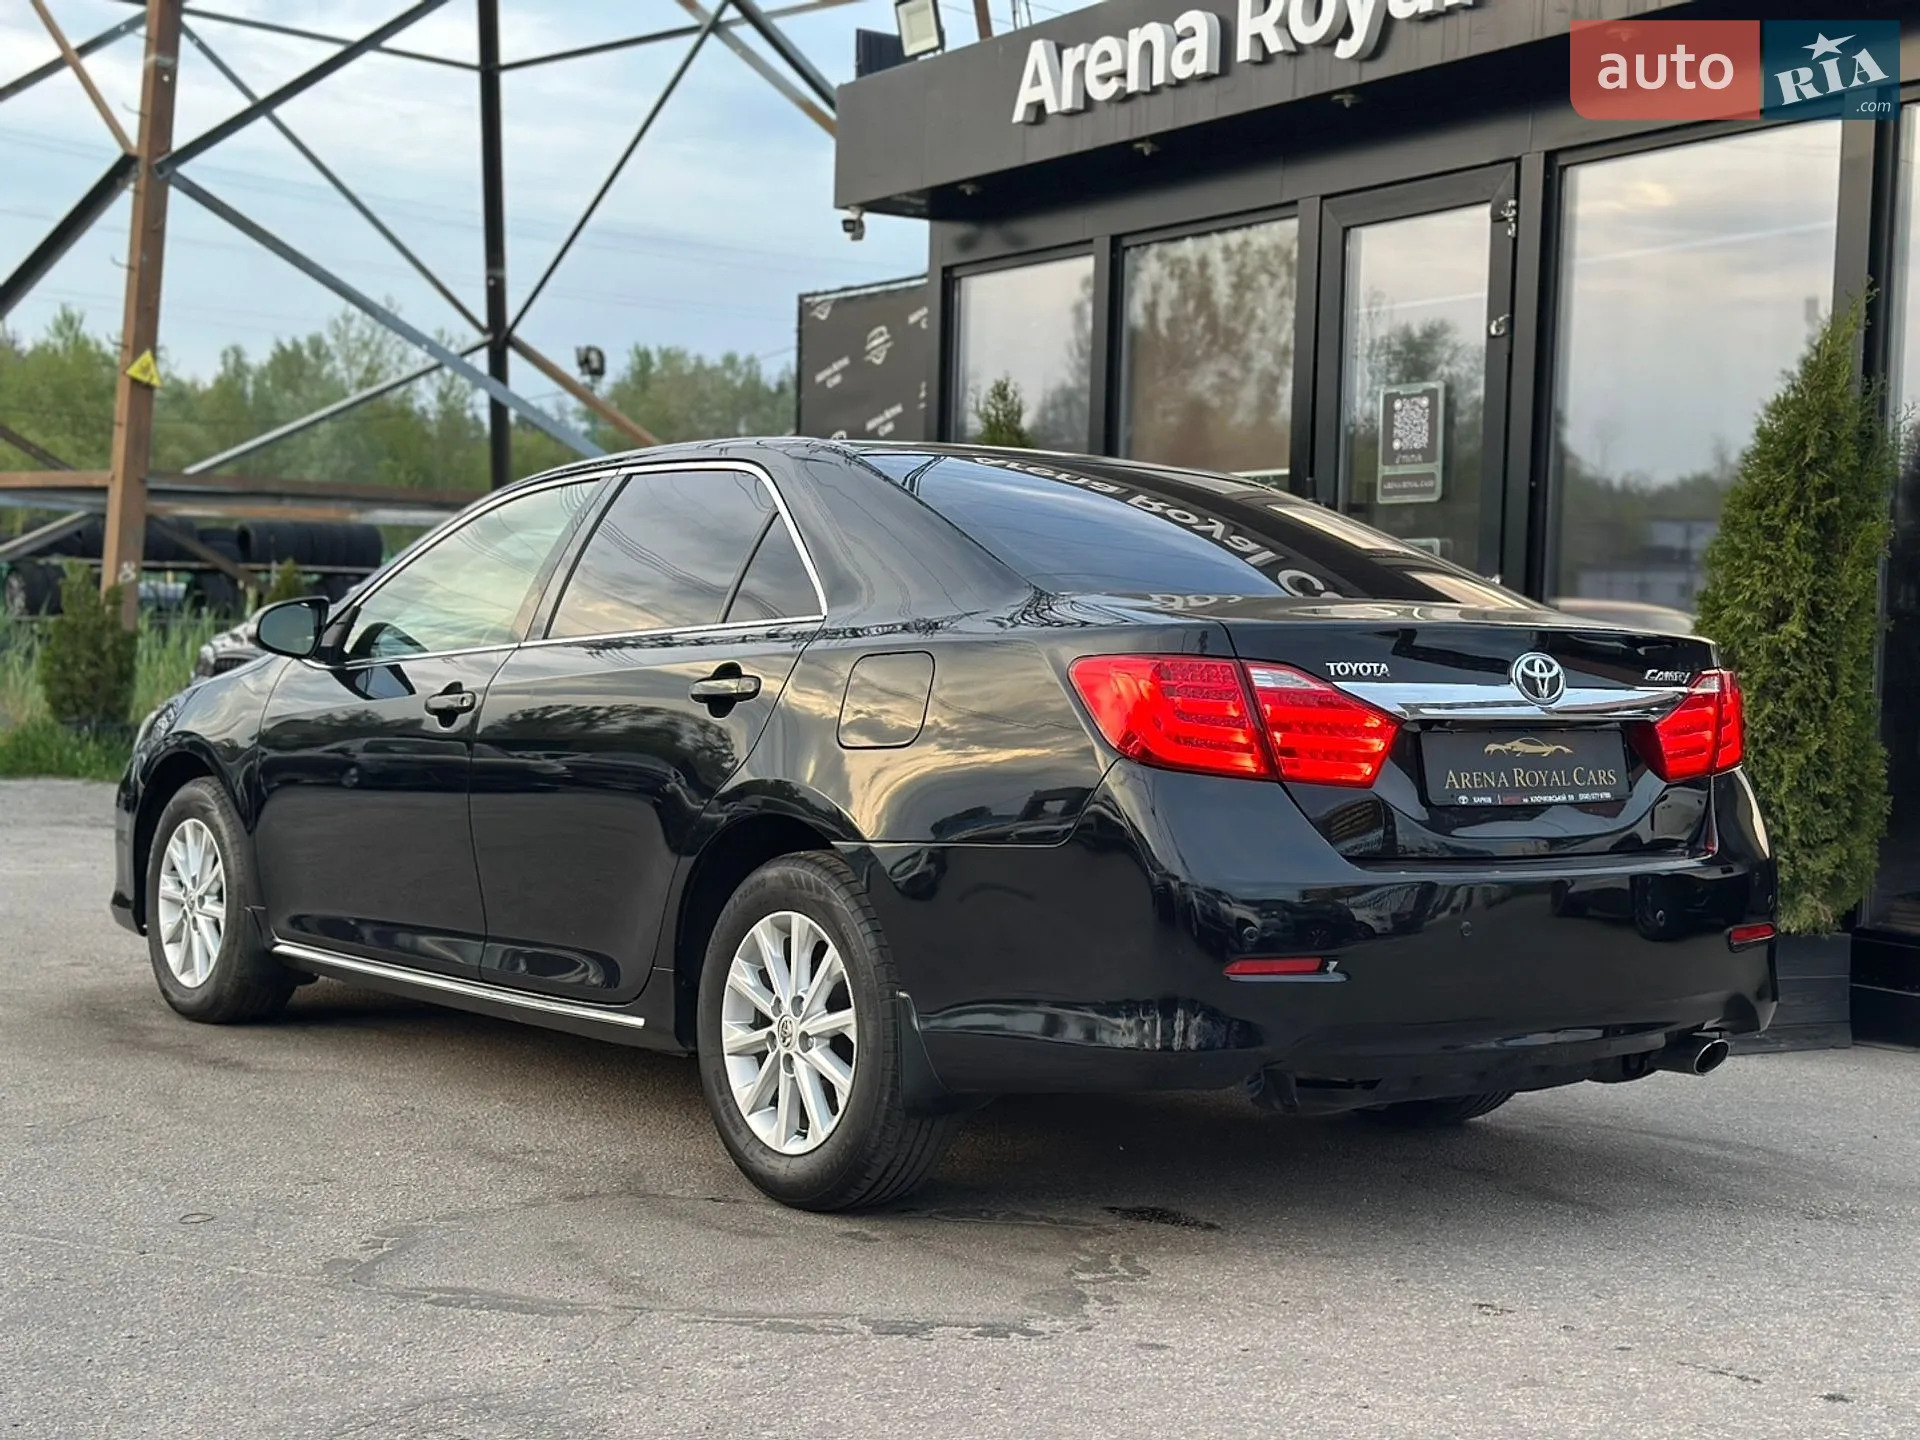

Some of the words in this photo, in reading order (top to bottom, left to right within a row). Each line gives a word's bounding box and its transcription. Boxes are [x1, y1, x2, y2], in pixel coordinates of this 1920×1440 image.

[1012, 9, 1220, 124] Arena
[1235, 0, 1475, 62] Roy
[1325, 661, 1390, 677] TOYOTA
[1445, 769, 1510, 790] ARENA
[1512, 767, 1572, 788] ROYAL
[1573, 766, 1617, 787] CARS
